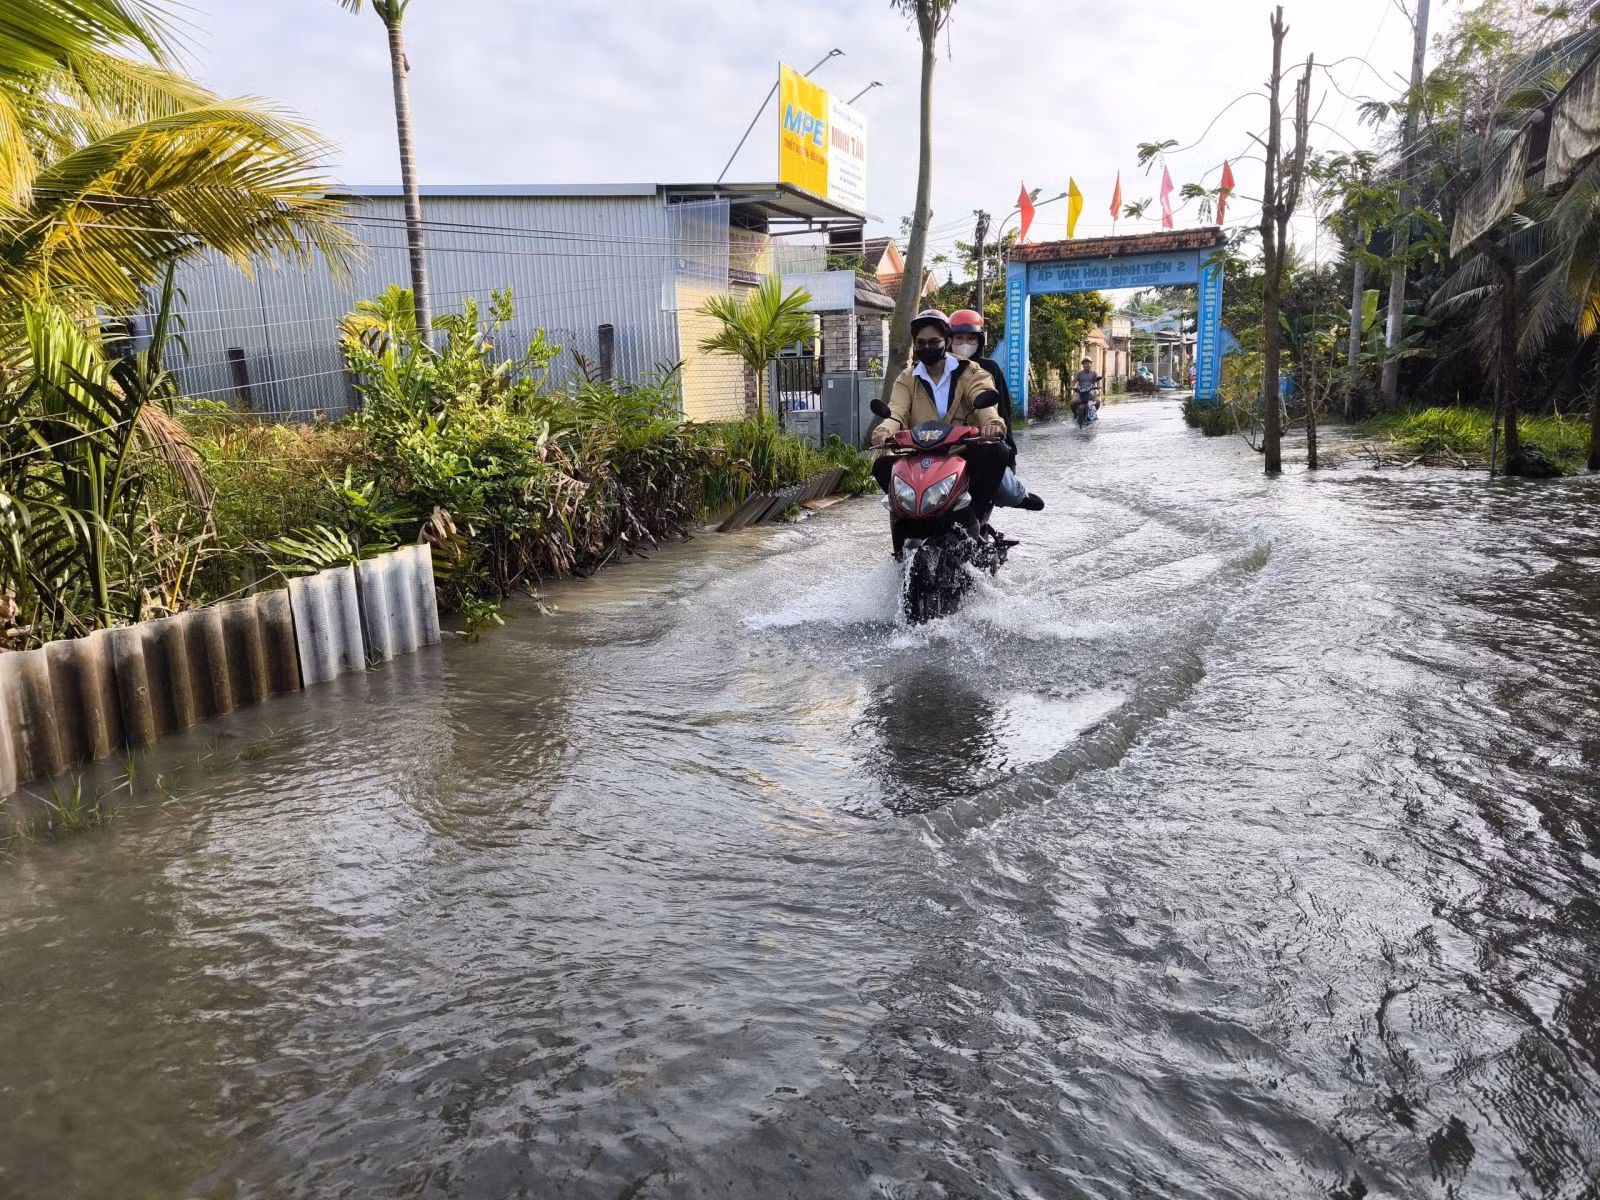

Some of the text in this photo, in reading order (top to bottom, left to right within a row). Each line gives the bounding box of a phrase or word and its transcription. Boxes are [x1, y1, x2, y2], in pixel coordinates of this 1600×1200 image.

[783, 102, 825, 147] MPE
[832, 126, 850, 155] MINH
[1058, 268, 1079, 280] VĂN
[1083, 265, 1107, 278] HÓA
[1177, 261, 1186, 272] 2
